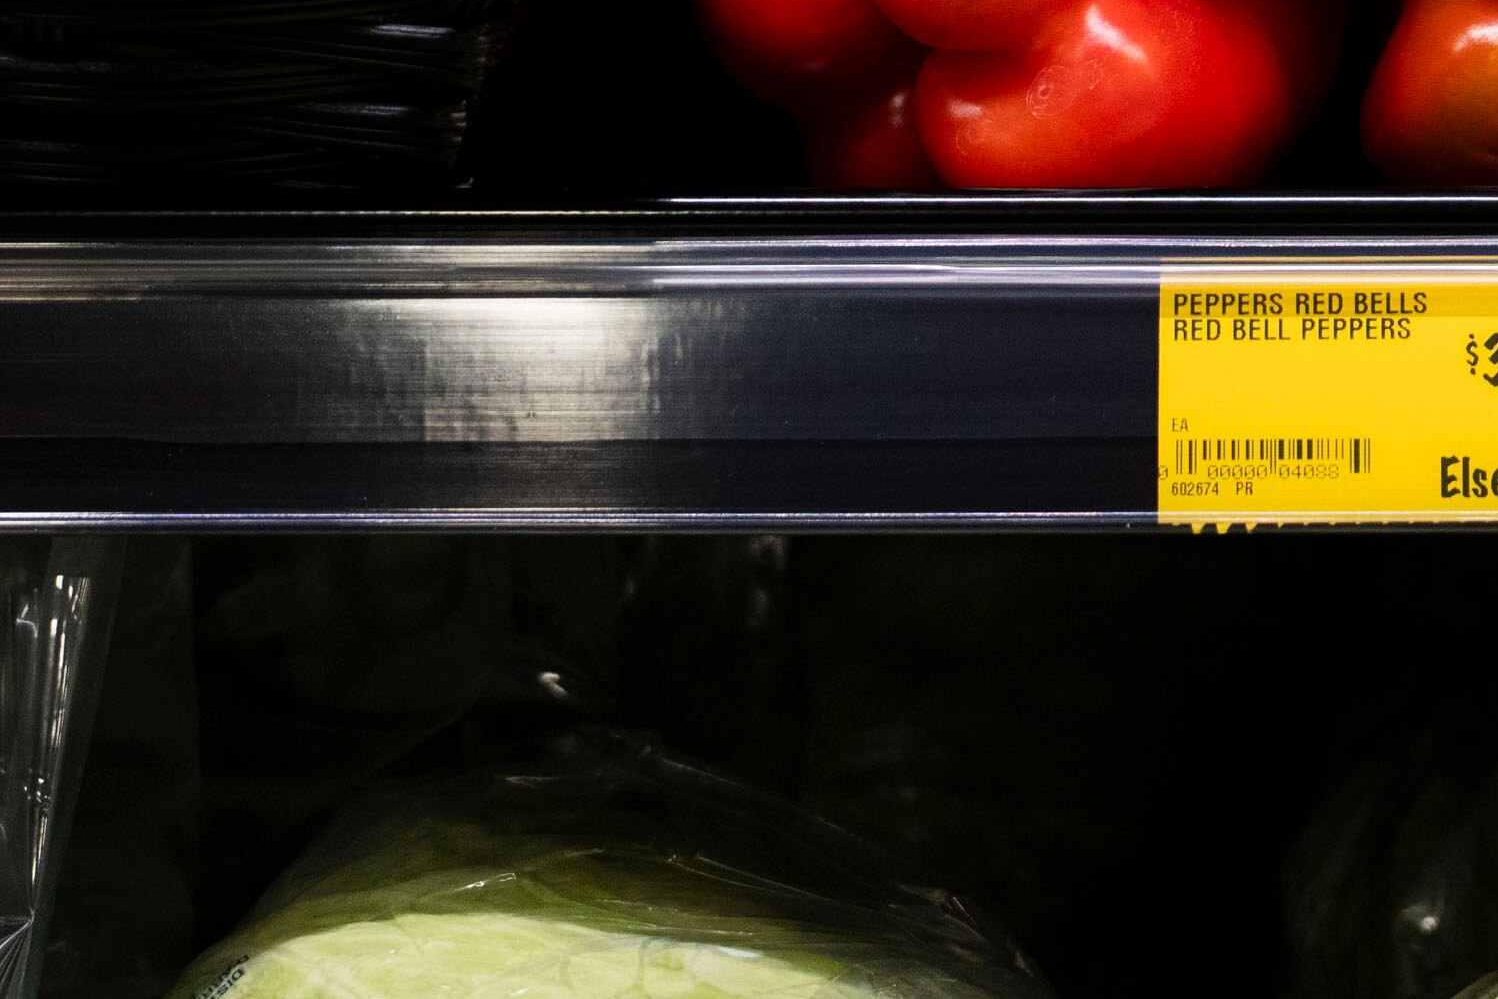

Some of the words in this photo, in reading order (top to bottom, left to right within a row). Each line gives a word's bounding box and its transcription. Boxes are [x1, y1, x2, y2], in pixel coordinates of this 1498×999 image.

[1173, 292, 1284, 316] PEPPERS
[1295, 292, 1344, 316] RED
[1354, 291, 1428, 315] BELLS
[1173, 318, 1222, 341] RED
[1232, 318, 1291, 341] BELL
[1301, 317, 1411, 340] PEPPERS
[1171, 417, 1189, 432] EA
[1279, 463, 1340, 480] 04088
[1171, 482, 1220, 497] 602674
[1235, 481, 1254, 496] PR
